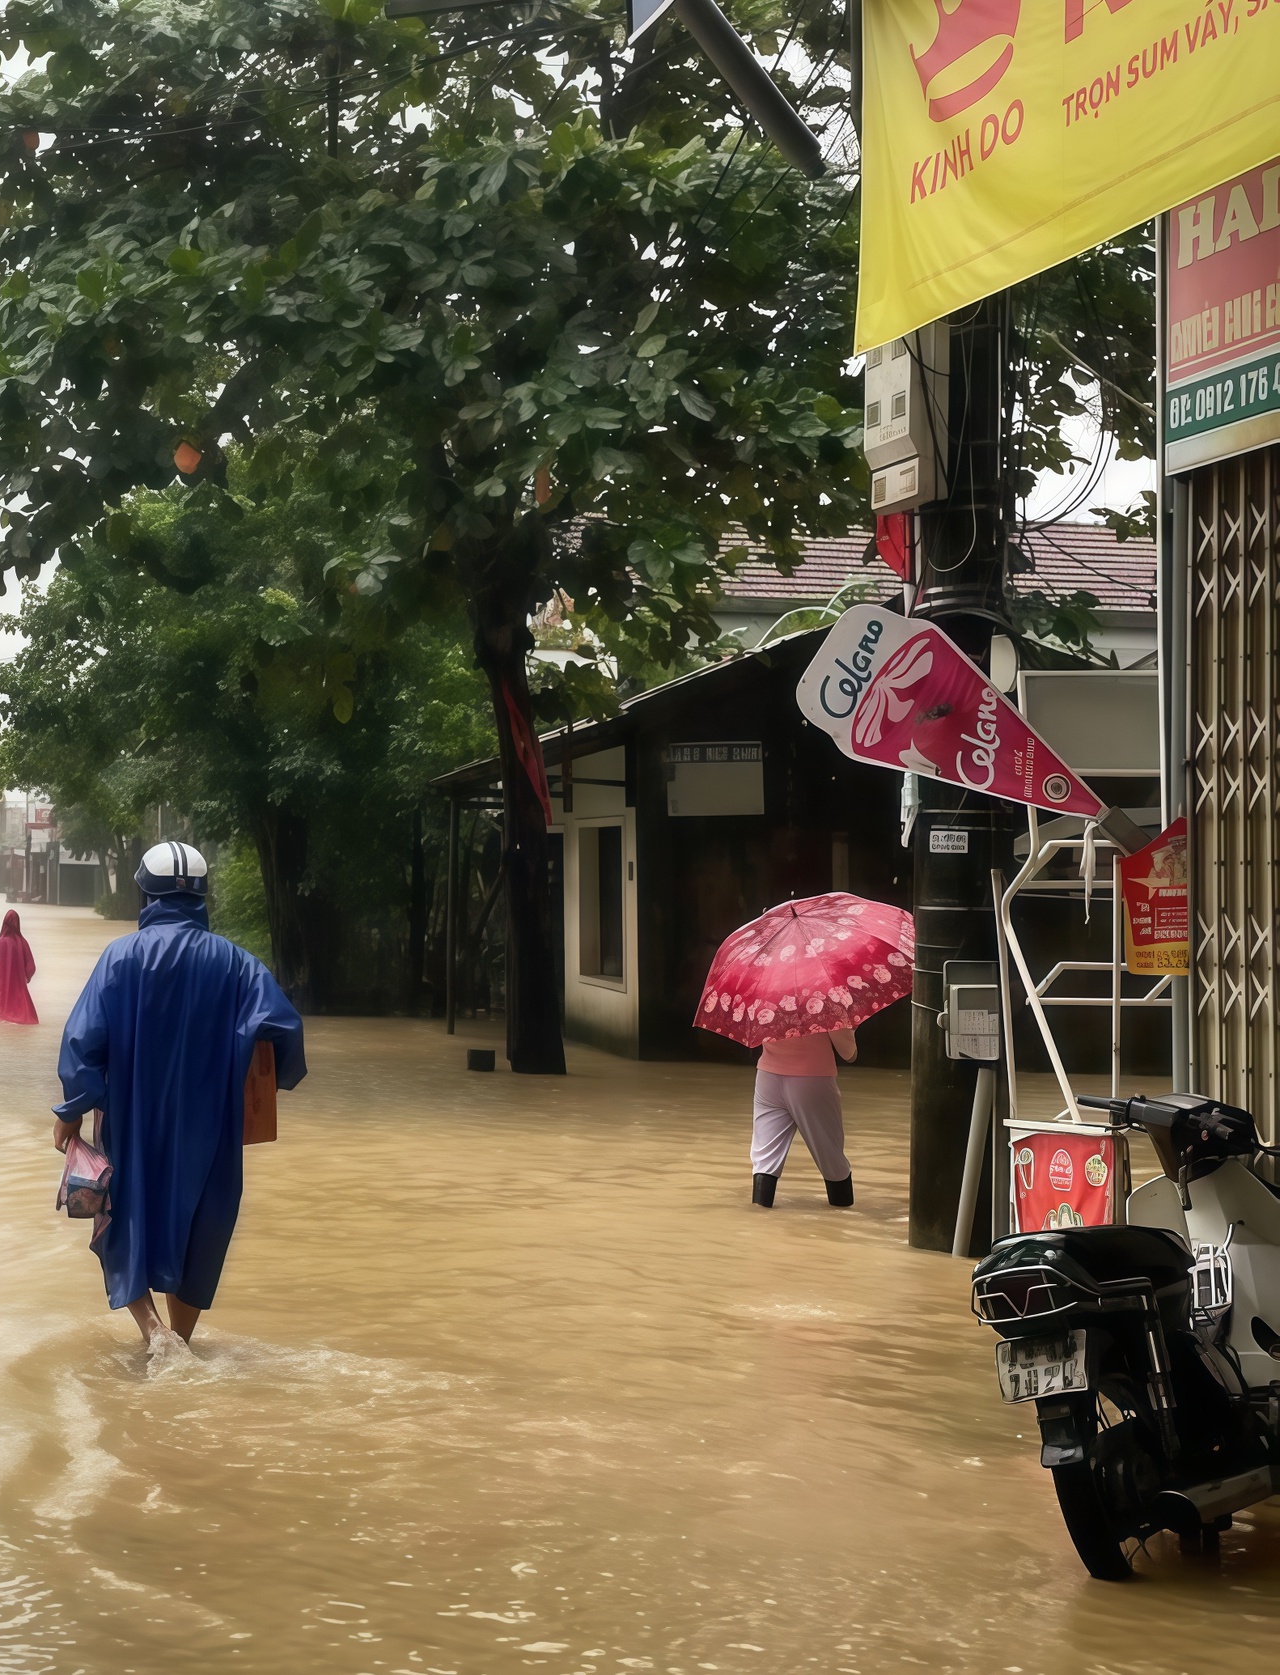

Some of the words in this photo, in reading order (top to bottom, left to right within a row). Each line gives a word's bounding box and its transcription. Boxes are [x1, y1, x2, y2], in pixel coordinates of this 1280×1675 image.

[1062, 64, 1121, 127] TRỌN
[1126, 29, 1179, 88] SUM
[910, 128, 974, 204] KINH
[820, 619, 884, 719] Celano
[955, 687, 1001, 791] Celano
